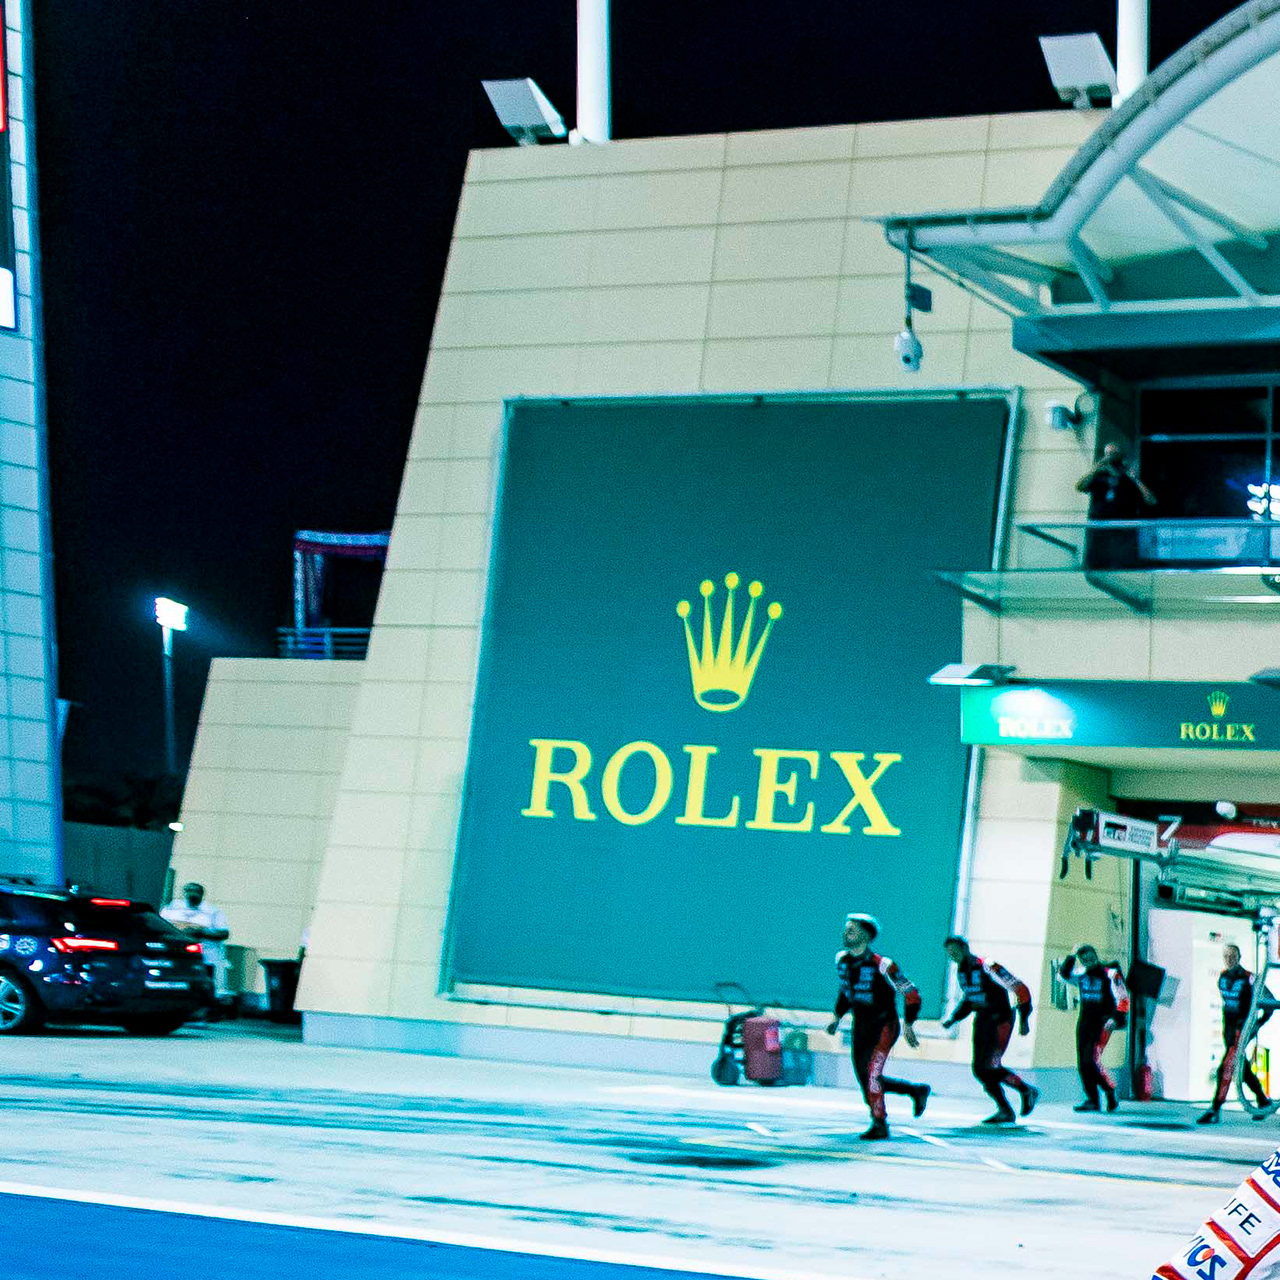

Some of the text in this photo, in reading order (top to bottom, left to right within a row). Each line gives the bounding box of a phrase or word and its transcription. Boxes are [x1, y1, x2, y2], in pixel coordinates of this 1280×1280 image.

[1180, 722, 1255, 741] ROLEX
[521, 738, 902, 837] ROLEX
[1158, 815, 1182, 841] 7
